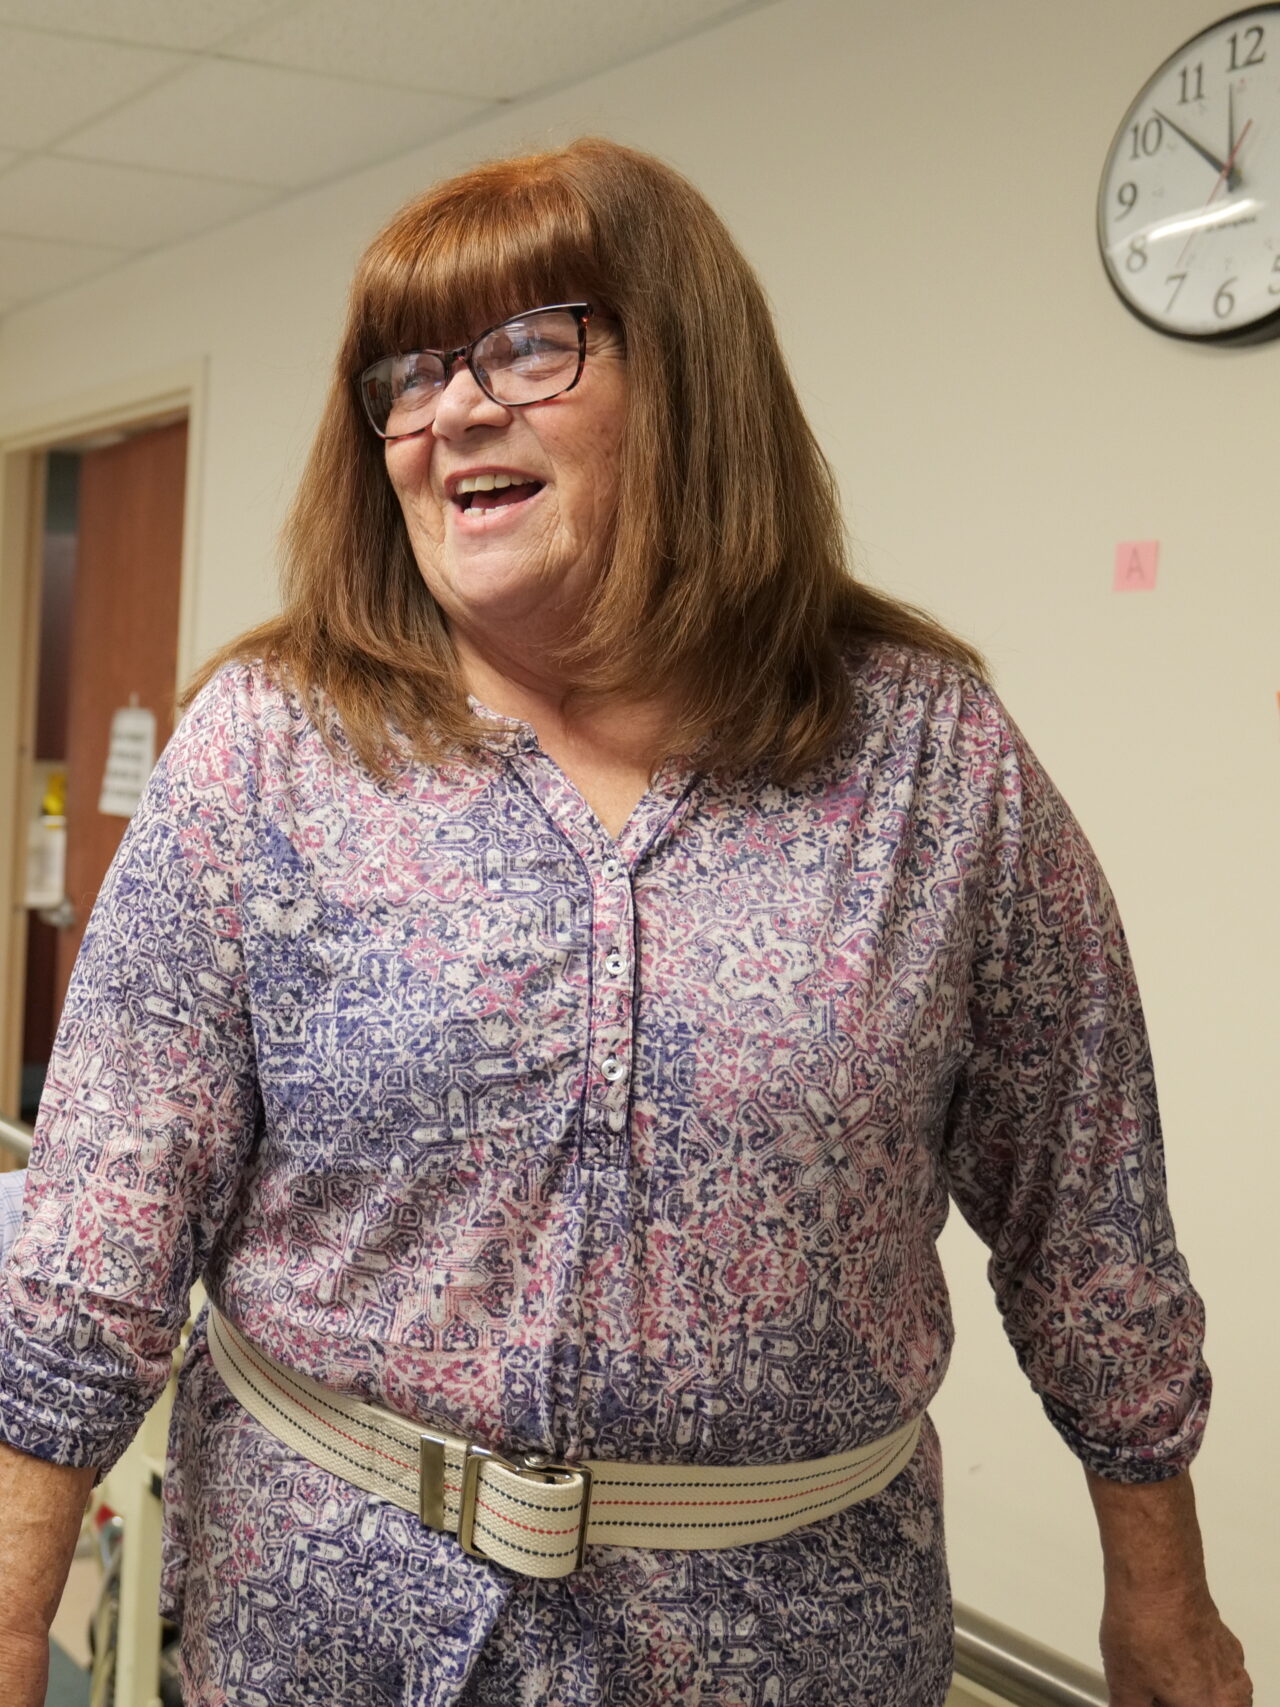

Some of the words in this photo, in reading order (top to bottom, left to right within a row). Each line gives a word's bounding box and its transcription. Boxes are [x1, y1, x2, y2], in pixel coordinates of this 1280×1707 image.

[1226, 25, 1267, 73] 12
[1177, 61, 1205, 105] 11
[1129, 117, 1163, 161] 10
[1114, 181, 1138, 222] 9
[1125, 235, 1148, 273] 8
[1165, 271, 1187, 313] 7
[1213, 276, 1238, 319] 6
[1125, 546, 1146, 582] A
